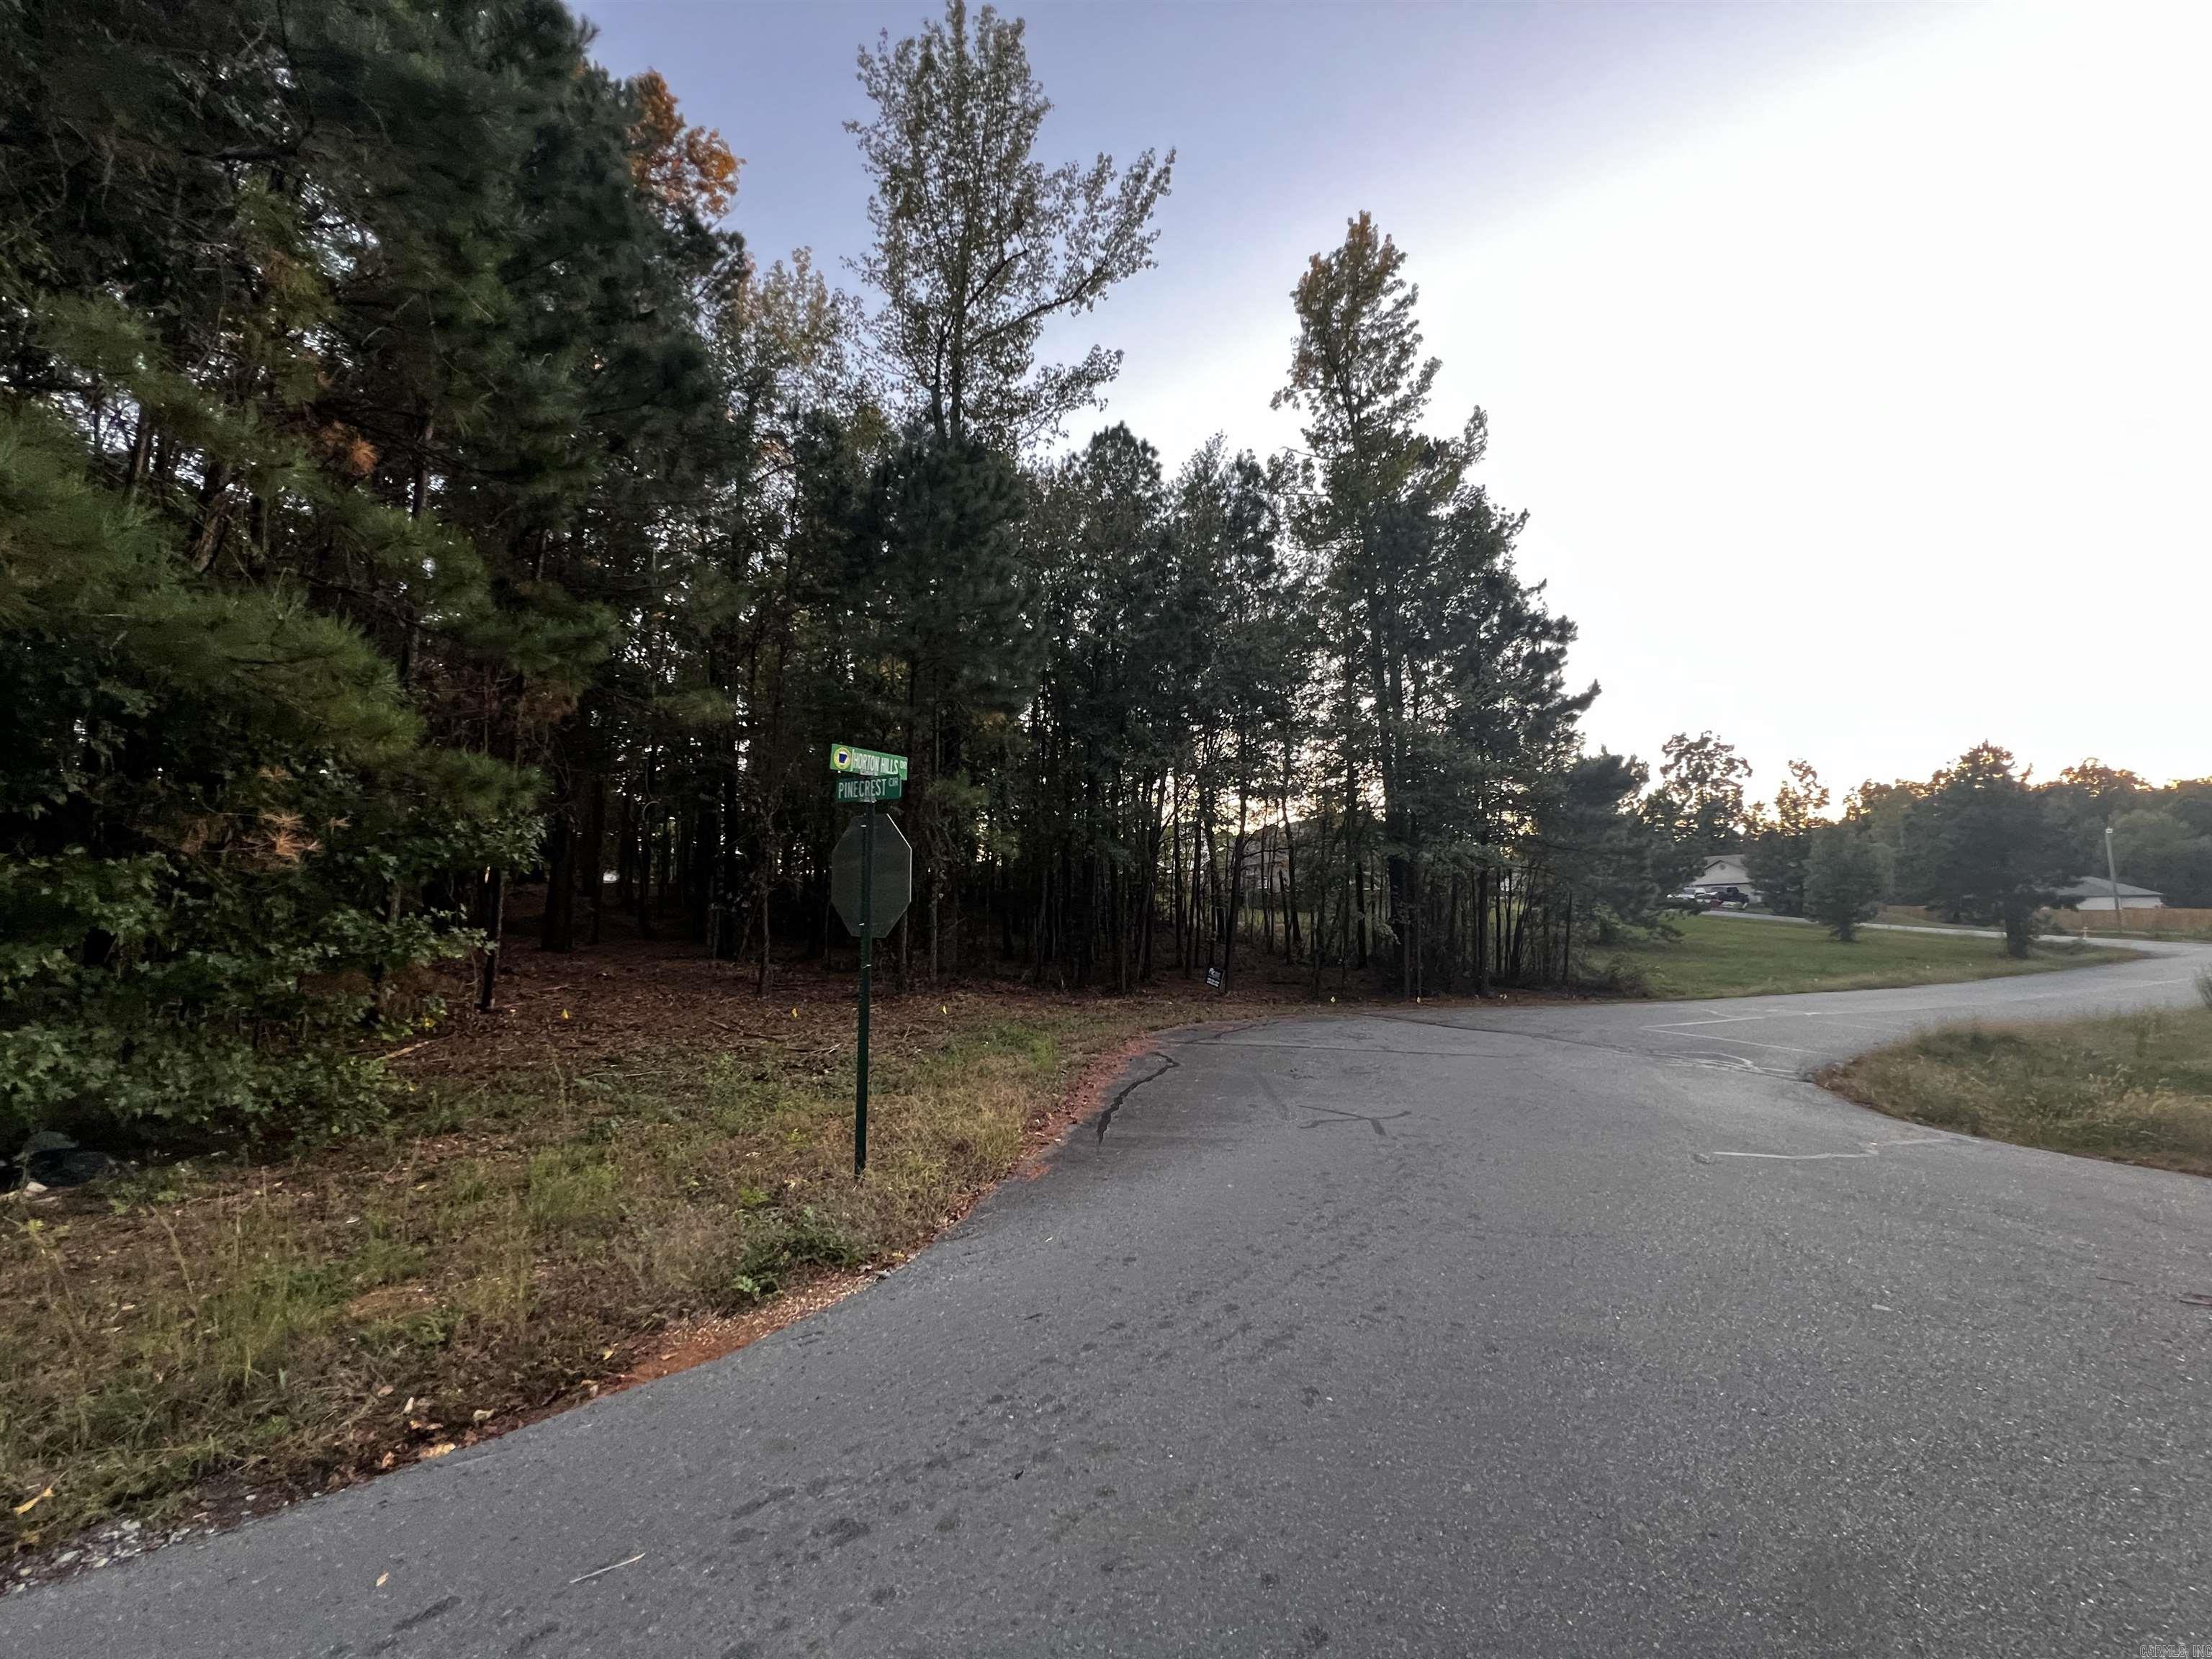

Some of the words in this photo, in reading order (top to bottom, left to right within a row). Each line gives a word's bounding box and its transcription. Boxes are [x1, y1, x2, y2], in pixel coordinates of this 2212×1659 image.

[853, 752, 880, 771] HORTON
[881, 757, 899, 774] HILLS
[900, 760, 907, 769] DR
[839, 779, 886, 799] PINECREST
[889, 778, 899, 786] CIR
